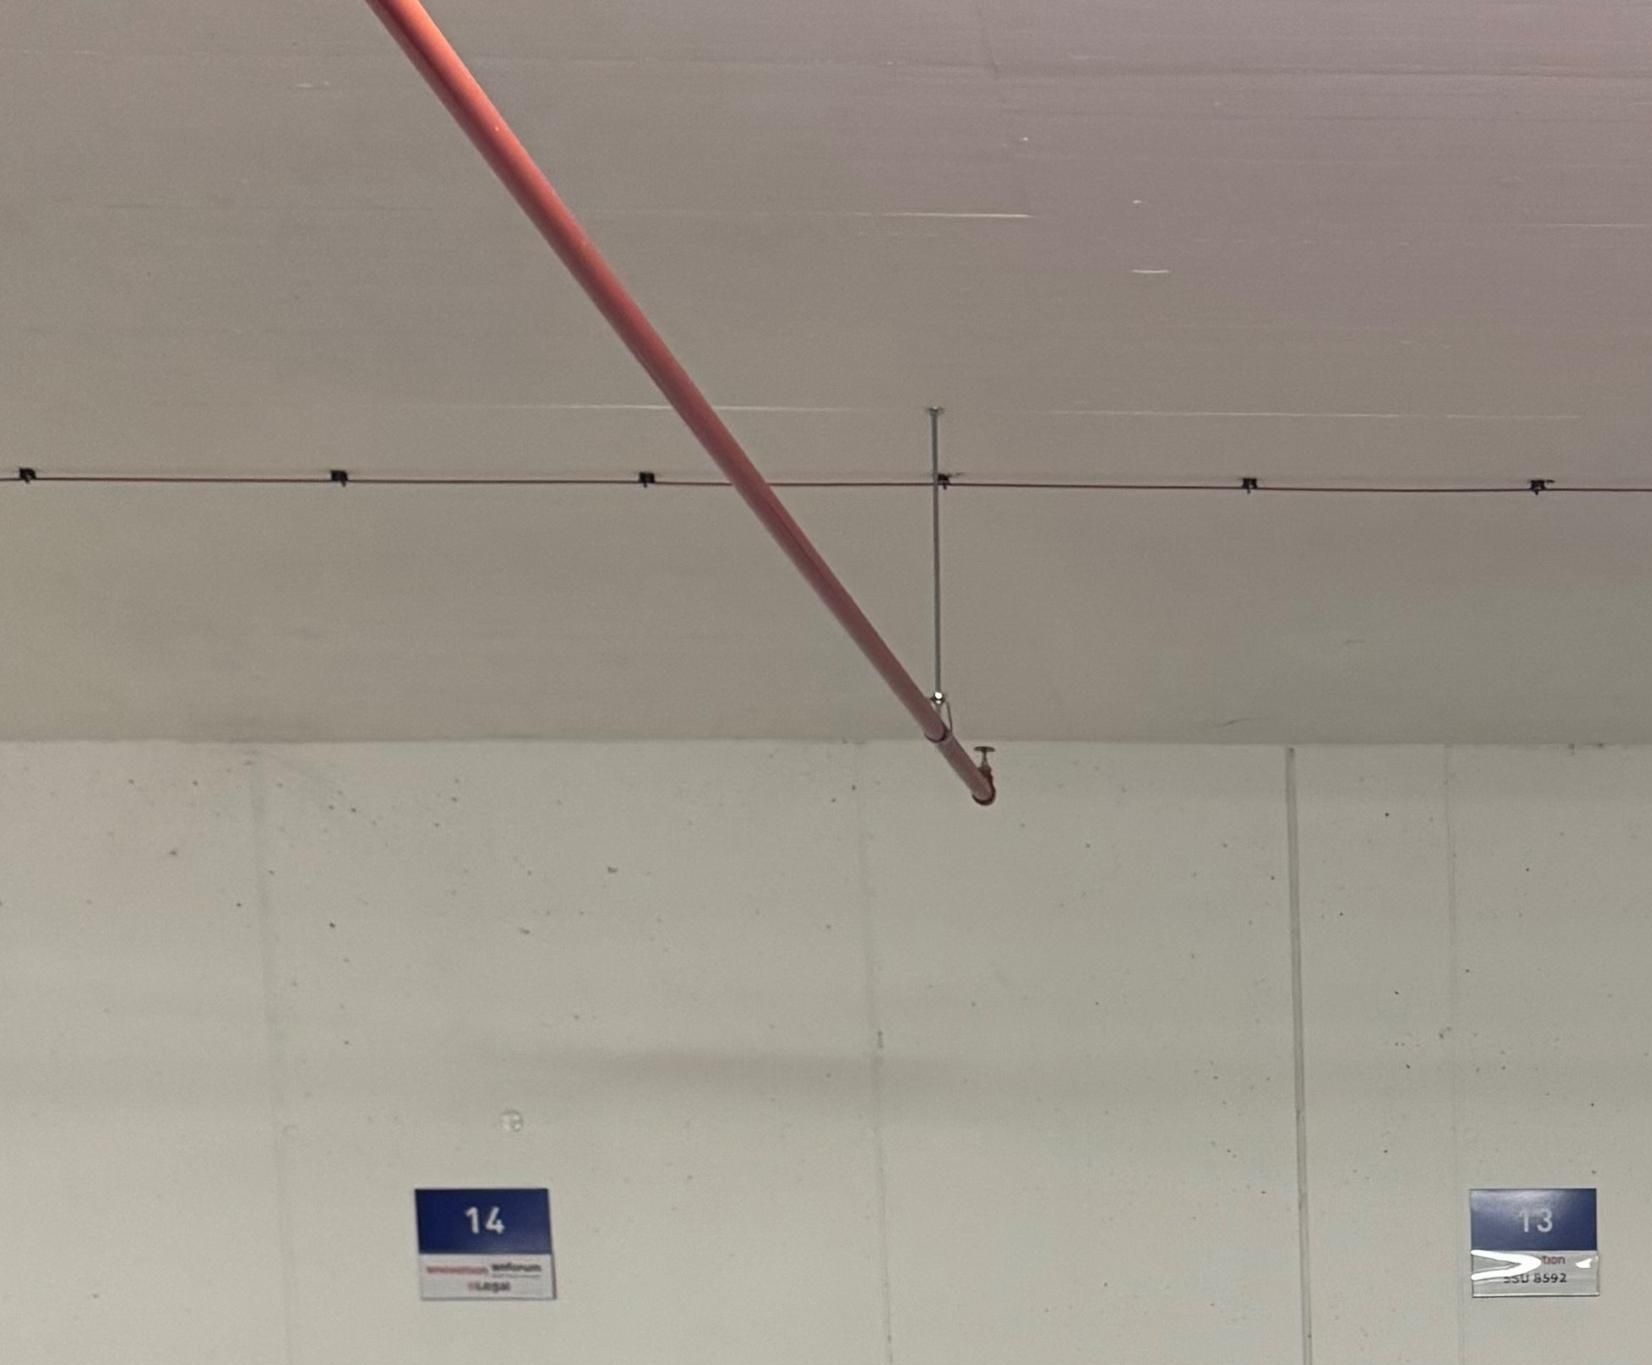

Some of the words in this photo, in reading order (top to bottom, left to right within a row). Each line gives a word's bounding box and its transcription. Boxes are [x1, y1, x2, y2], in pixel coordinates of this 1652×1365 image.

[465, 1206, 505, 1234] 14
[1519, 1209, 1553, 1233] 13
[1533, 1273, 1568, 1284] 8592
